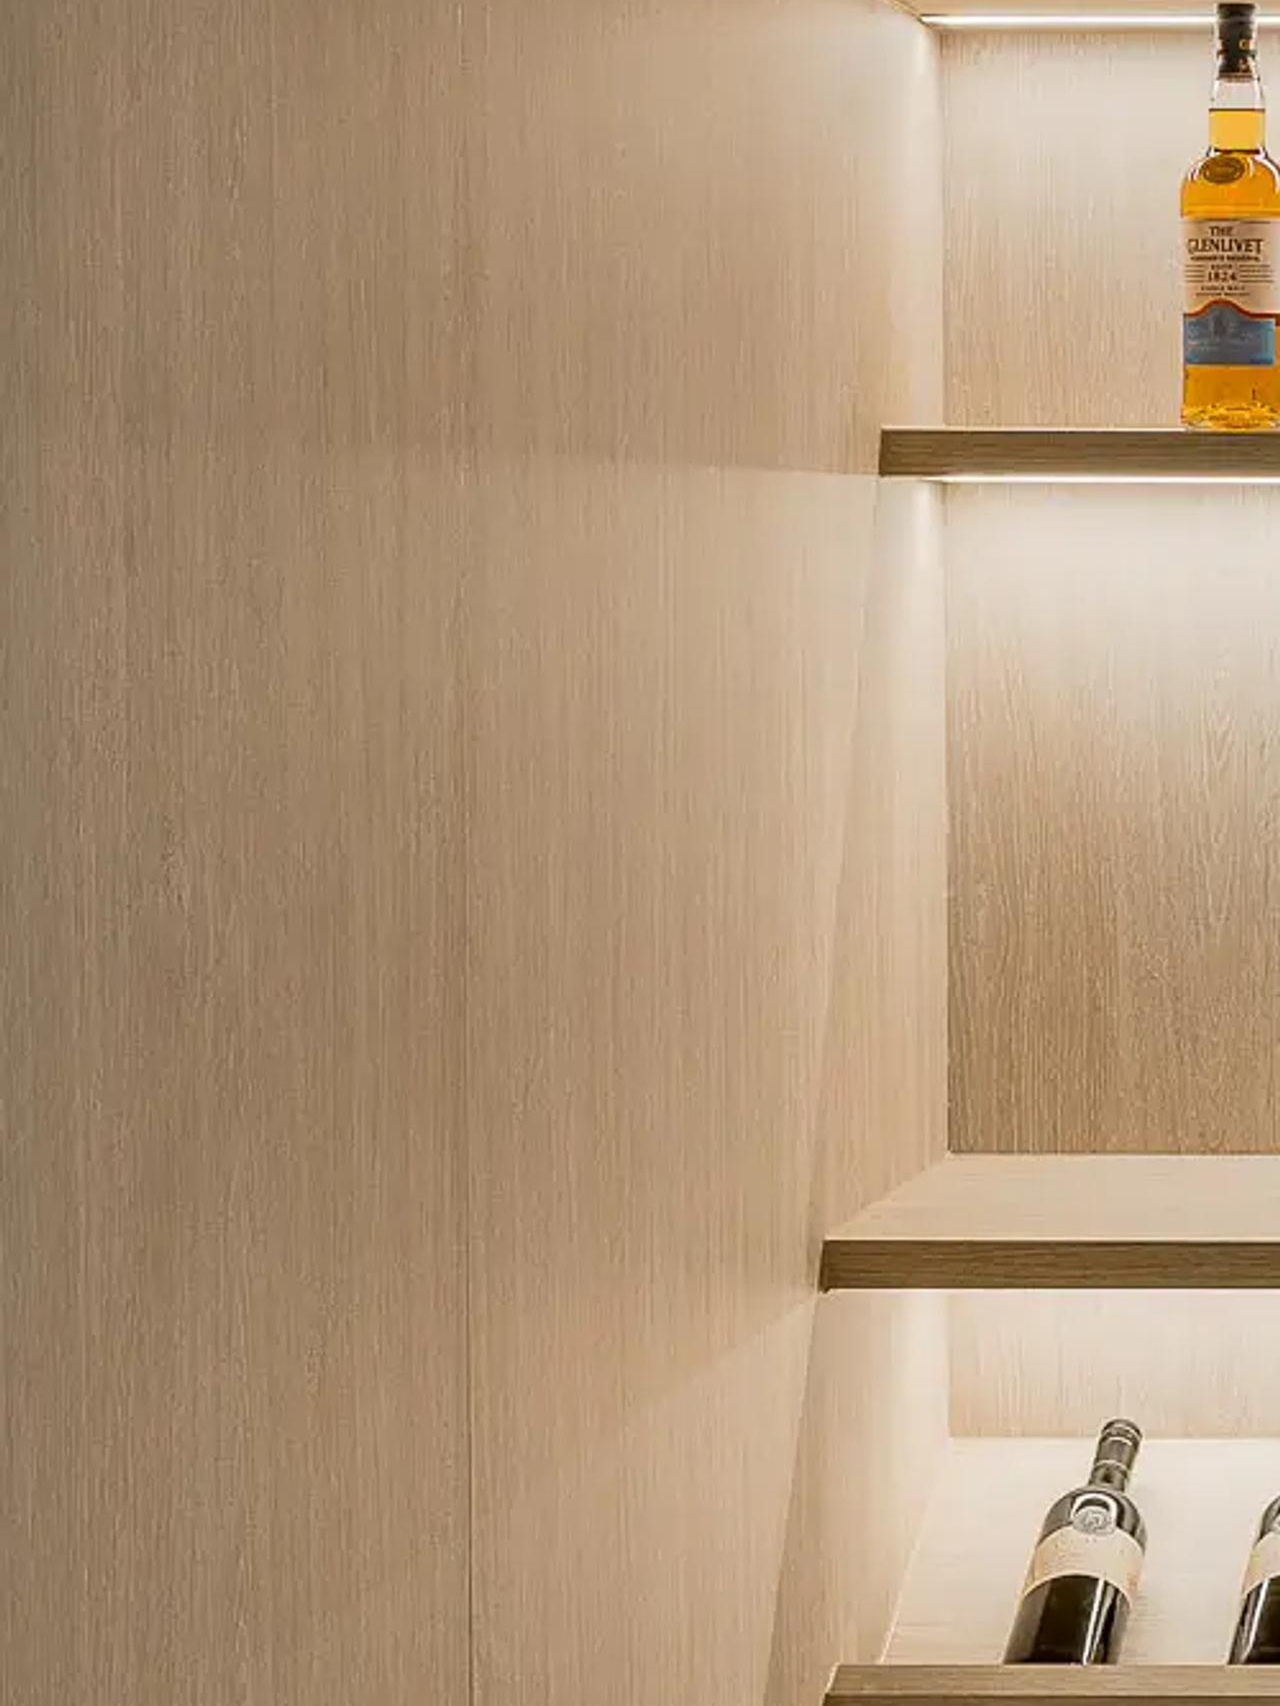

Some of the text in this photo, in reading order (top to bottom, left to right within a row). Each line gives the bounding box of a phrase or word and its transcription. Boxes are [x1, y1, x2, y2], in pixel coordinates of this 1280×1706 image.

[1208, 225, 1233, 237] THE
[1187, 237, 1265, 255] GLENLIVET
[1208, 271, 1237, 282] 1824
